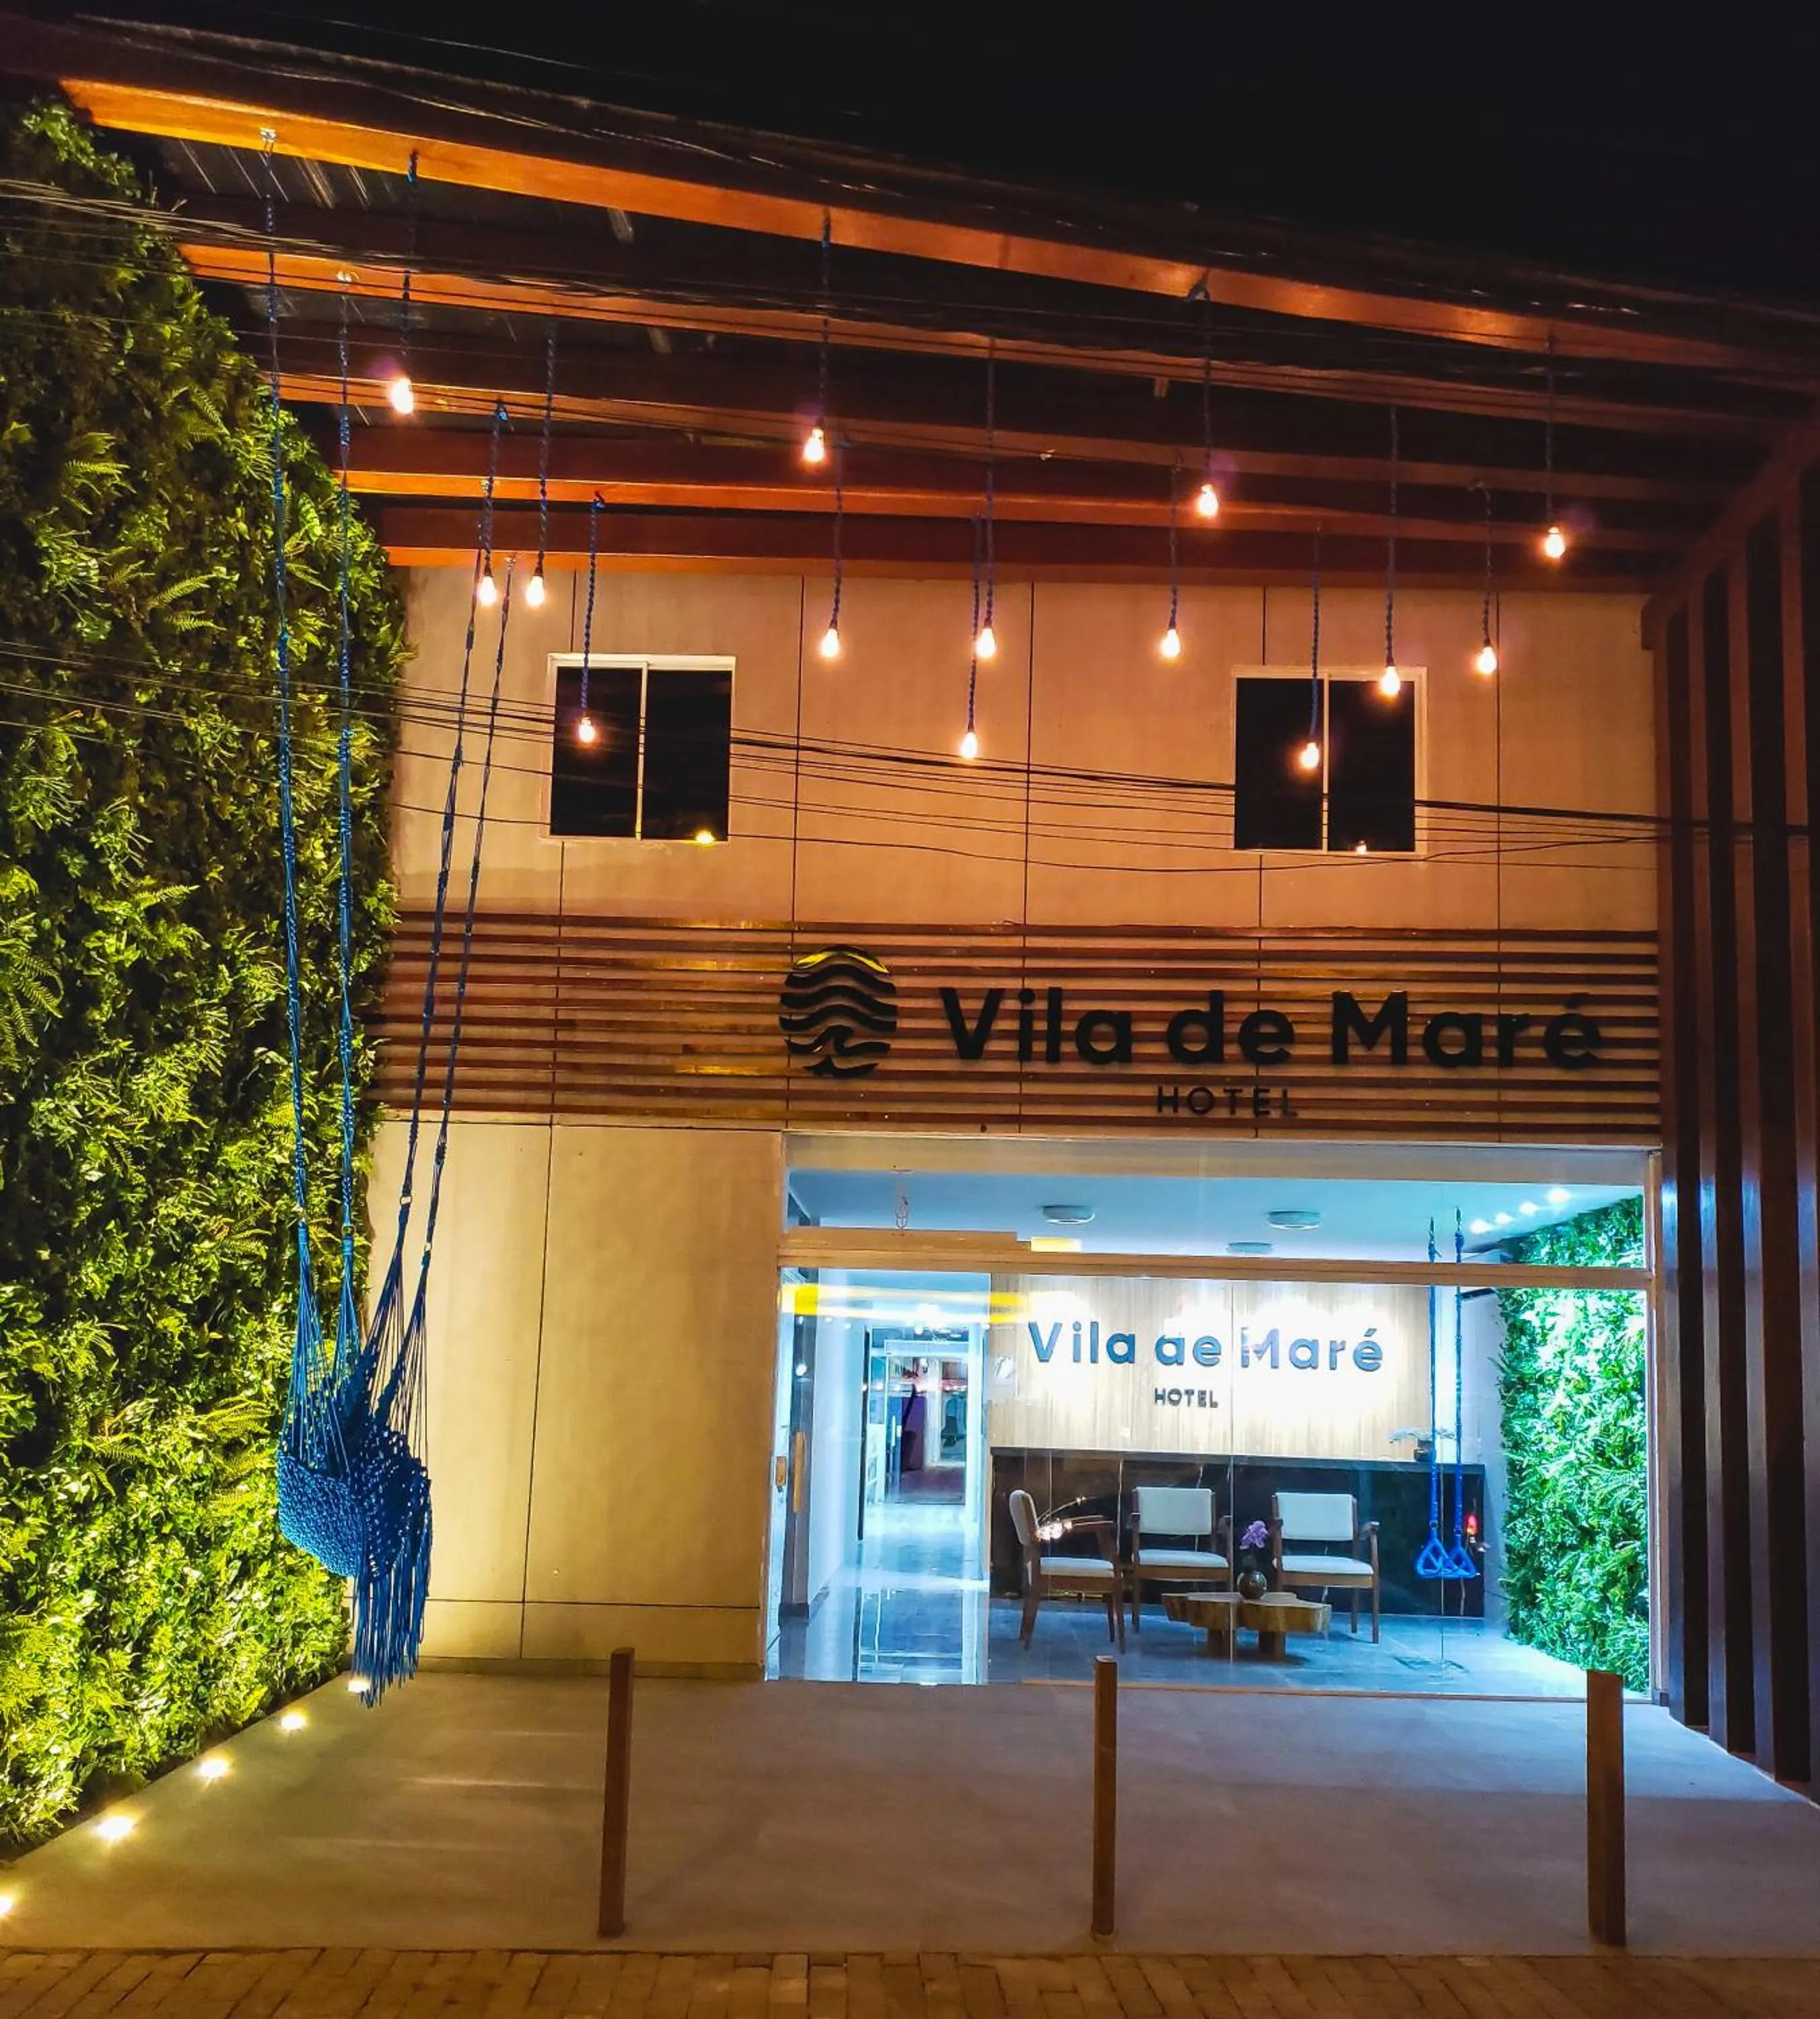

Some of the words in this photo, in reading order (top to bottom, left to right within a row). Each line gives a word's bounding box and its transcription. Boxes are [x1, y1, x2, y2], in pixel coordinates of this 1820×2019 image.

[940, 987, 1133, 1063] Vila
[1166, 989, 1295, 1064] de
[1332, 990, 1602, 1069] Maré
[1156, 1085, 1298, 1118] HOTEL
[1028, 1321, 1135, 1364] Vila
[1240, 1326, 1383, 1372] Maré
[1154, 1388, 1219, 1409] HOTEL
